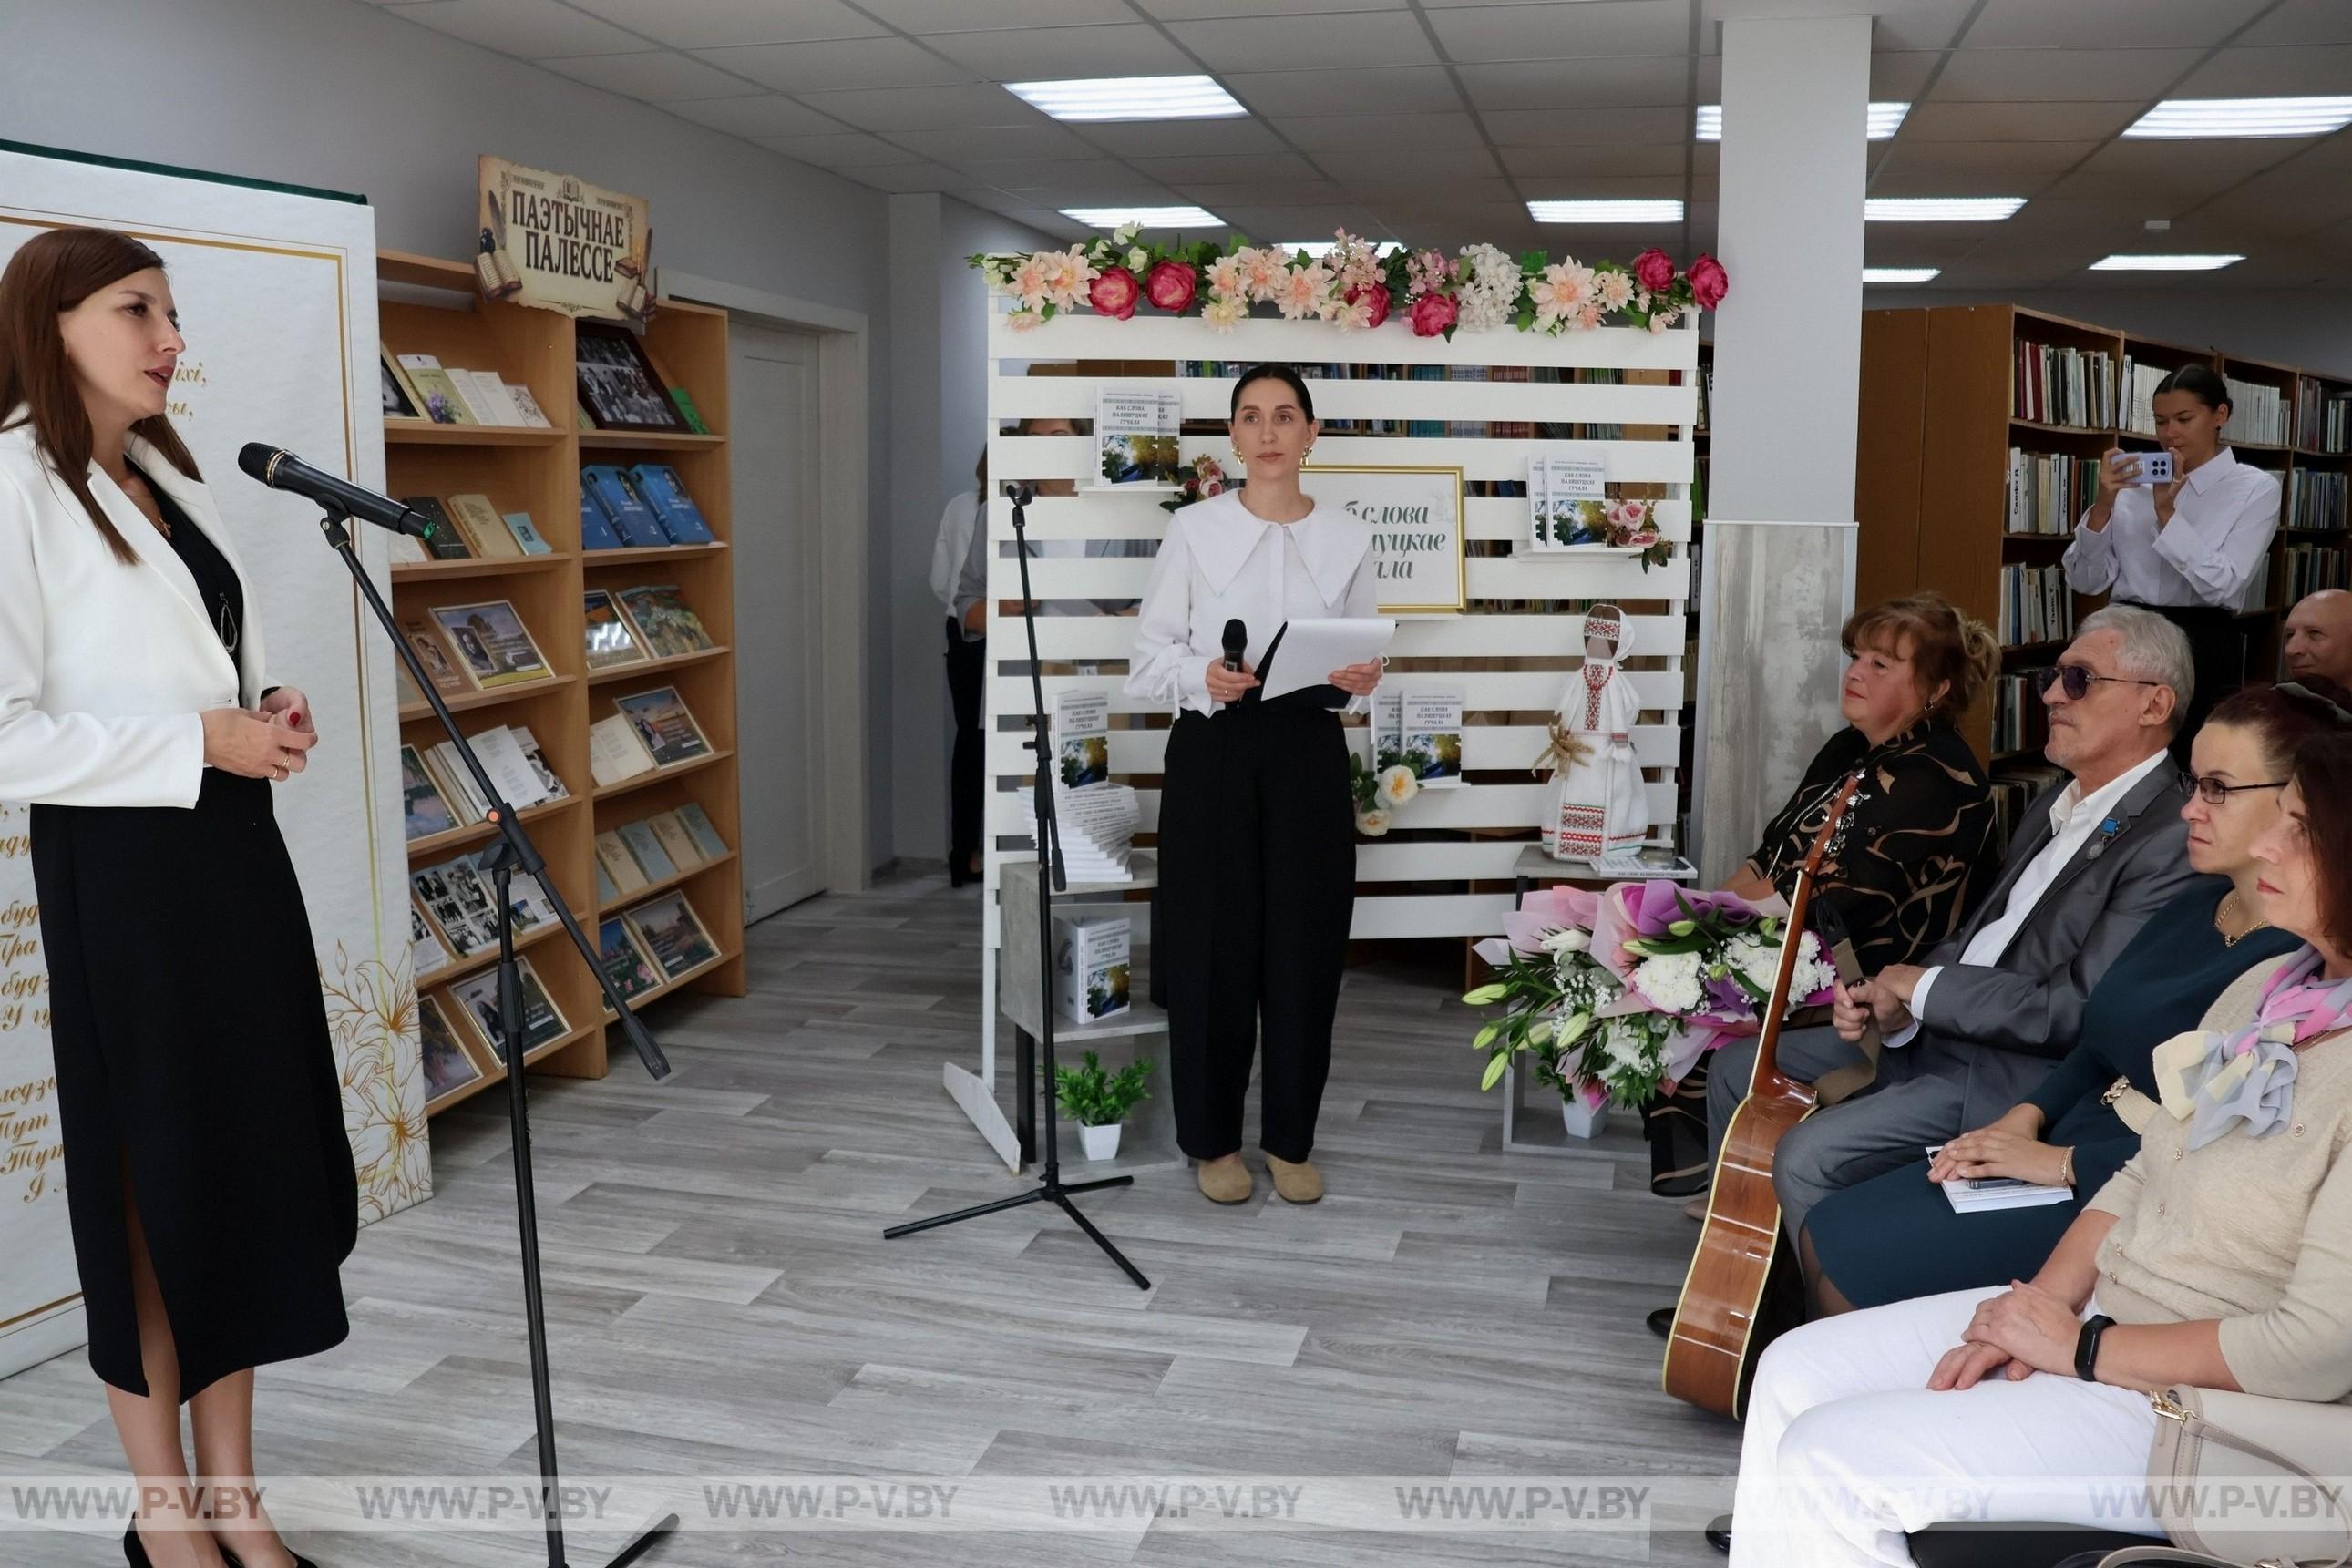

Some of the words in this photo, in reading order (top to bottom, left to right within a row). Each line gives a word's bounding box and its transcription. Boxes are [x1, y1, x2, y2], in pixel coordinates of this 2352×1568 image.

[511, 189, 625, 249] ПАЭТЫЧНАЕ
[525, 230, 614, 284] ПАЛЕССЕ
[1371, 532, 1446, 559] уцкае
